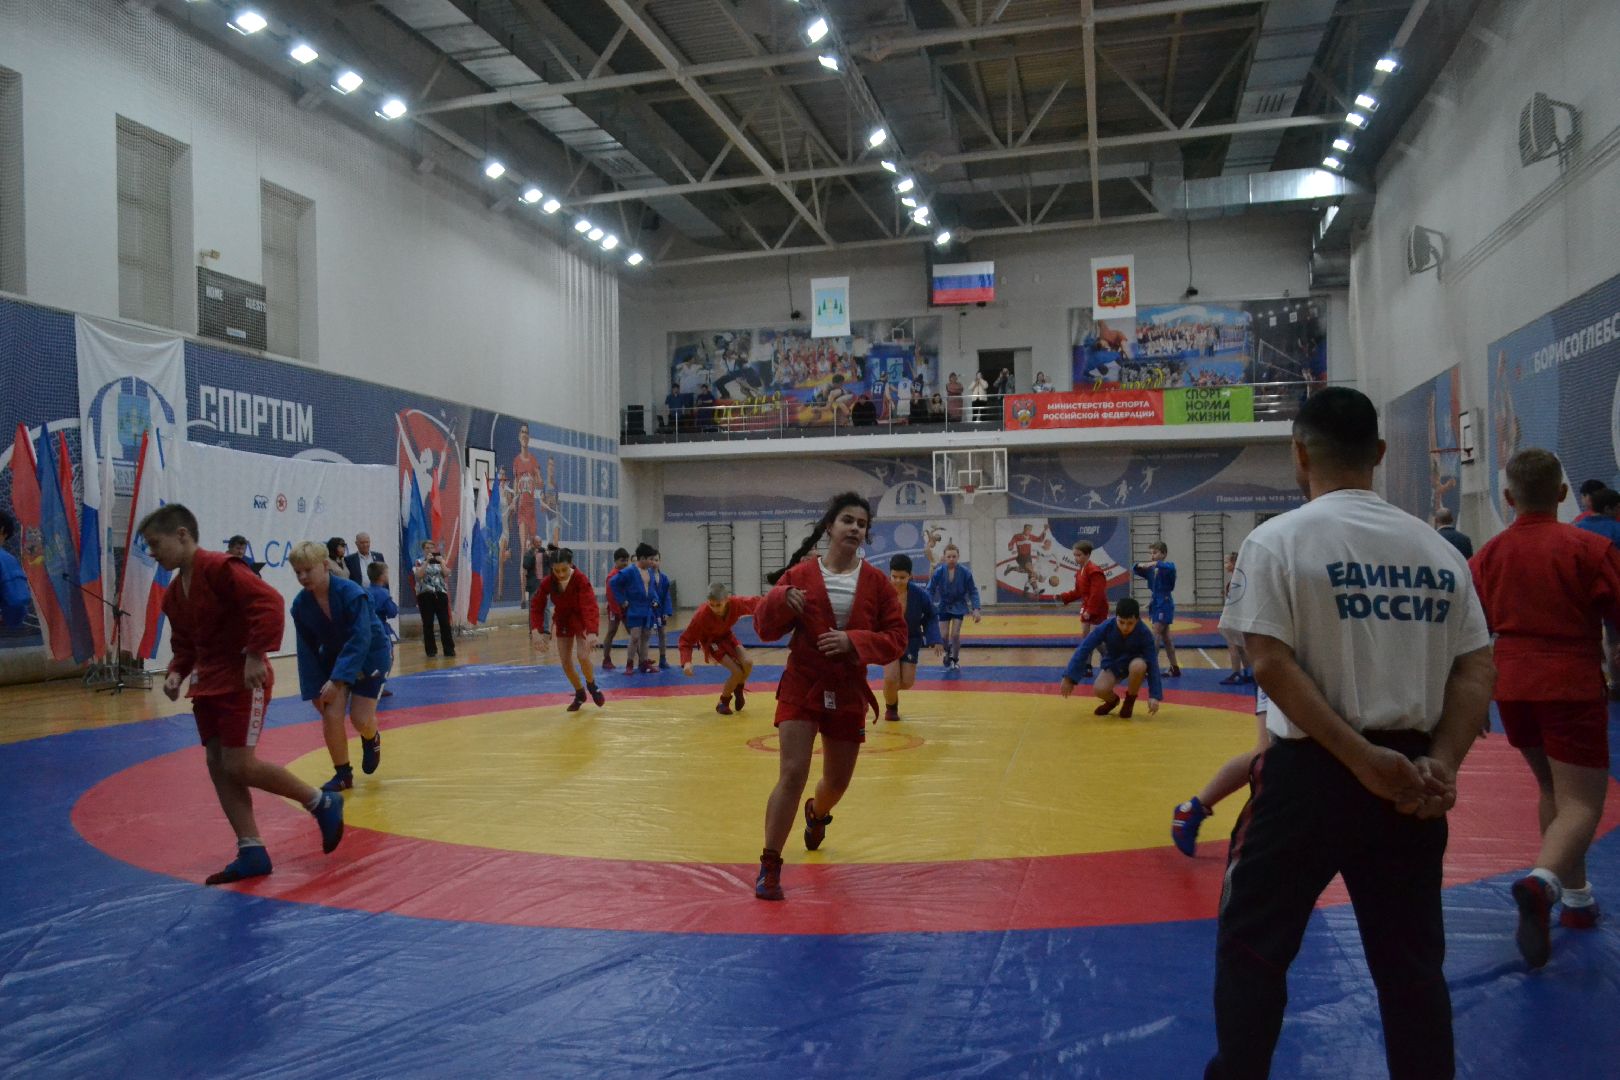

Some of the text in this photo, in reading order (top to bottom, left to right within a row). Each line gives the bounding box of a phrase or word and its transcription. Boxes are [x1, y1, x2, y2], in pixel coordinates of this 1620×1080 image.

[1185, 388, 1221, 399] СПОРТ
[1047, 400, 1150, 410] МИНИСТЕРСТВО СПОРТА
[1185, 399, 1231, 410] НОРМА
[199, 384, 313, 445] СПОРТОМ
[1043, 410, 1155, 421] РОССИЙСКОЙ ФЕДЕРАЦИИ
[1186, 411, 1231, 422] ЖИЗНИ
[1326, 561, 1456, 593] ЕДИНАЯ
[1335, 593, 1451, 623] РОССИЯ
